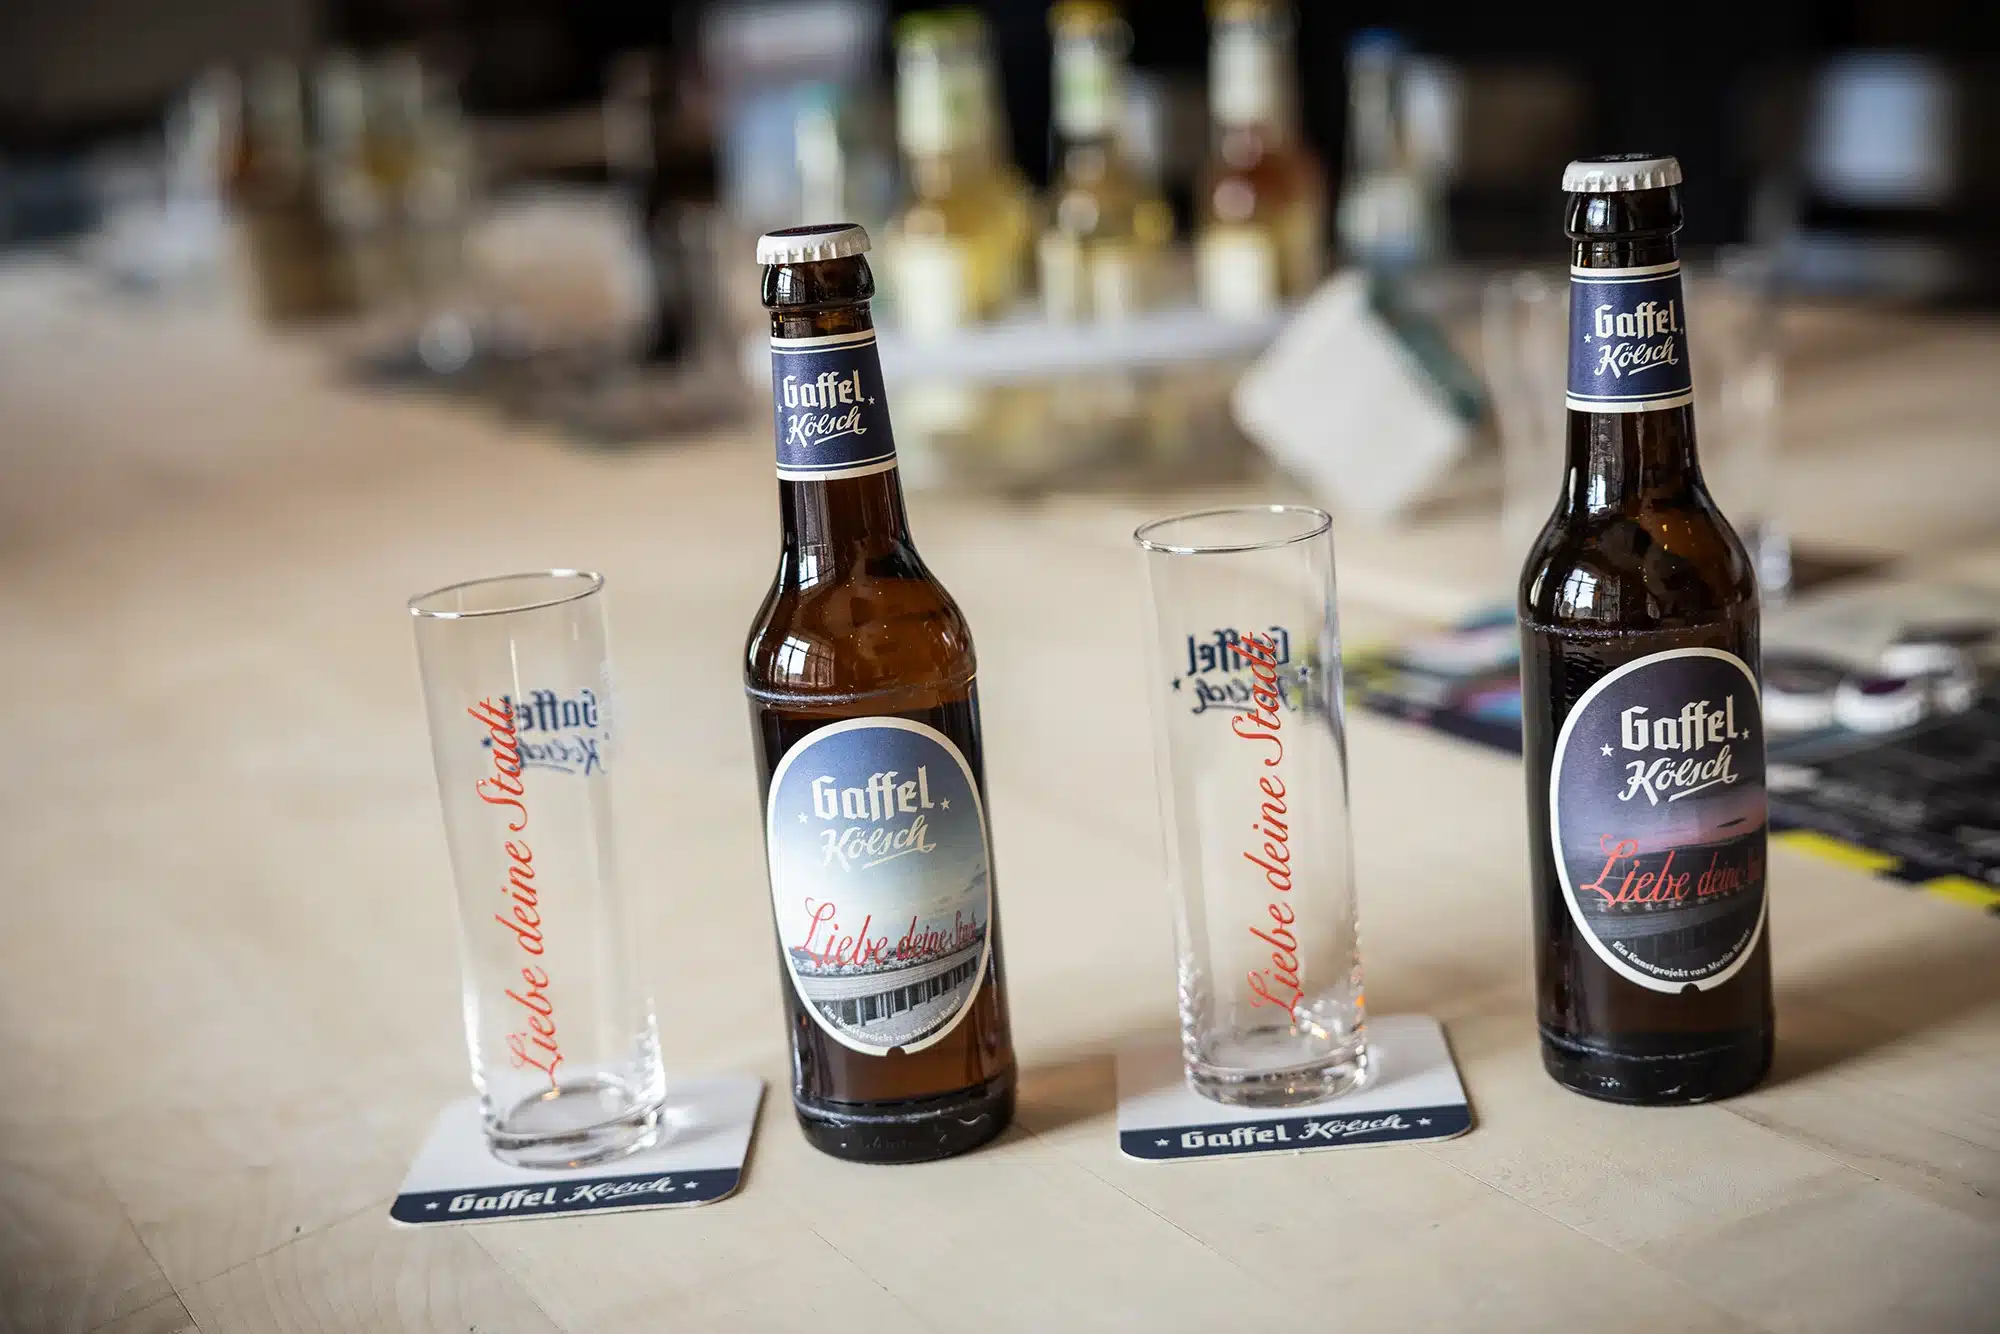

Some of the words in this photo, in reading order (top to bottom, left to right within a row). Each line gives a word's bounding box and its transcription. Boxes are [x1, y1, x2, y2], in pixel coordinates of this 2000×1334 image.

[1594, 300, 1678, 339] Gaffel
[1594, 336, 1679, 378] Kölsch
[783, 369, 864, 409] Gaffel
[785, 406, 867, 448] Kölsch
[1226, 631, 1284, 767] Stadt
[1620, 695, 1738, 752] Gaffel
[468, 697, 528, 833] Stadt
[811, 765, 935, 822] Gaffel
[1617, 744, 1738, 807] Kölsch
[819, 814, 936, 872] Kölsch
[1243, 774, 1292, 892] deine
[495, 839, 544, 956] deine
[1580, 833, 1690, 907] Liebe
[795, 897, 888, 969] Liebe
[896, 915, 949, 961] deine
[1612, 940, 1628, 957] Ein
[1627, 952, 1689, 978] Kunstprojekt
[1690, 967, 1707, 976] von
[1246, 901, 1304, 1023] Liebe
[505, 964, 565, 1089] Liebe
[823, 1005, 838, 1021] Ein
[836, 1016, 893, 1041] Kunstprojekt
[895, 1032, 912, 1041] von
[913, 1016, 941, 1036] Merlin
[1180, 1124, 1292, 1150] Gaffel
[1298, 1114, 1411, 1140] Kölsch
[448, 1187, 558, 1213] Gaffel
[562, 1175, 677, 1203] Kölsch
